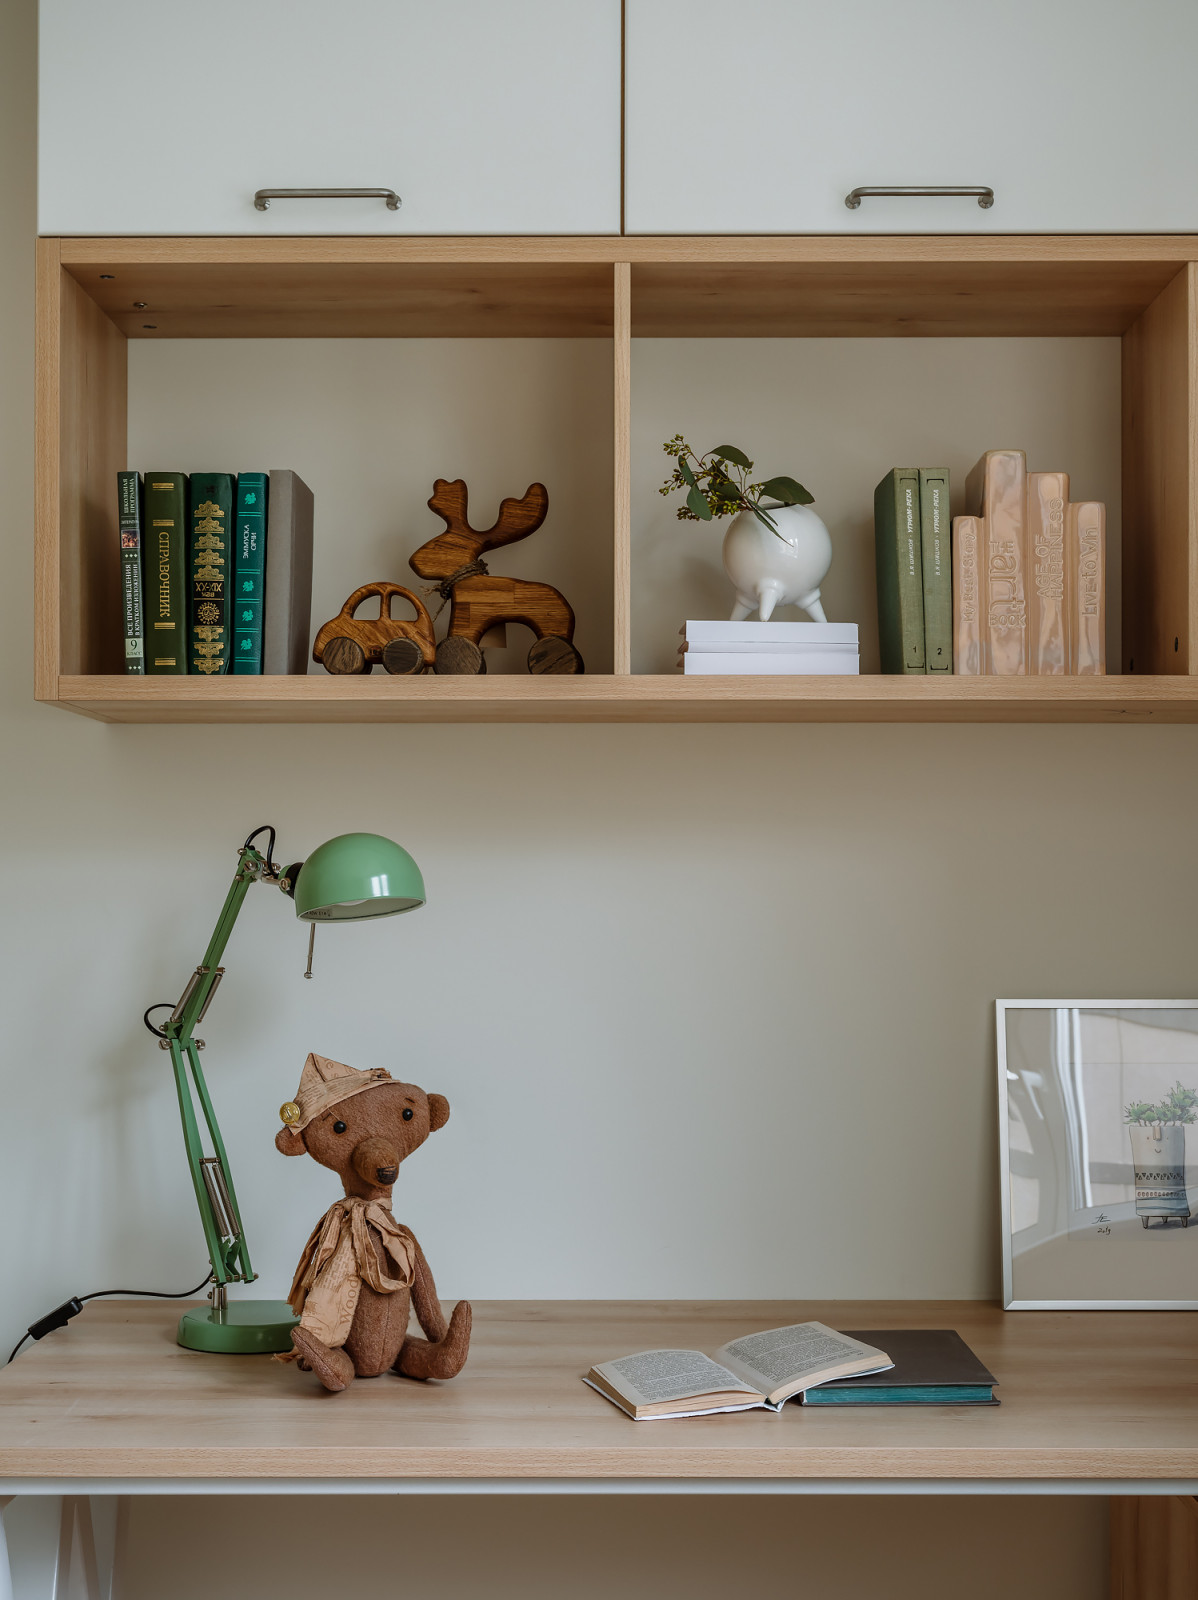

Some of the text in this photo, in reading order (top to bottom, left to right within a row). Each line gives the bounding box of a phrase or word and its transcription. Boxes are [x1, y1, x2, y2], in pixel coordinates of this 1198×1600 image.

[242, 524, 250, 559] ЭММУСКА
[989, 541, 1014, 554] THE
[1048, 498, 1064, 600] HAPPINESS
[1080, 527, 1098, 558] Win
[158, 531, 170, 618] СПРАВОЧНИК
[961, 533, 976, 623] My Best Story
[989, 554, 1026, 614] art
[1035, 534, 1050, 599] AGE OF
[1082, 560, 1098, 579] to
[125, 564, 133, 621] ПРОИЗВЕДЕНИЯ
[988, 613, 1026, 627] BOOK
[130, 639, 138, 650] 9
[912, 646, 917, 654] 1
[339, 1274, 359, 1326] Wood
